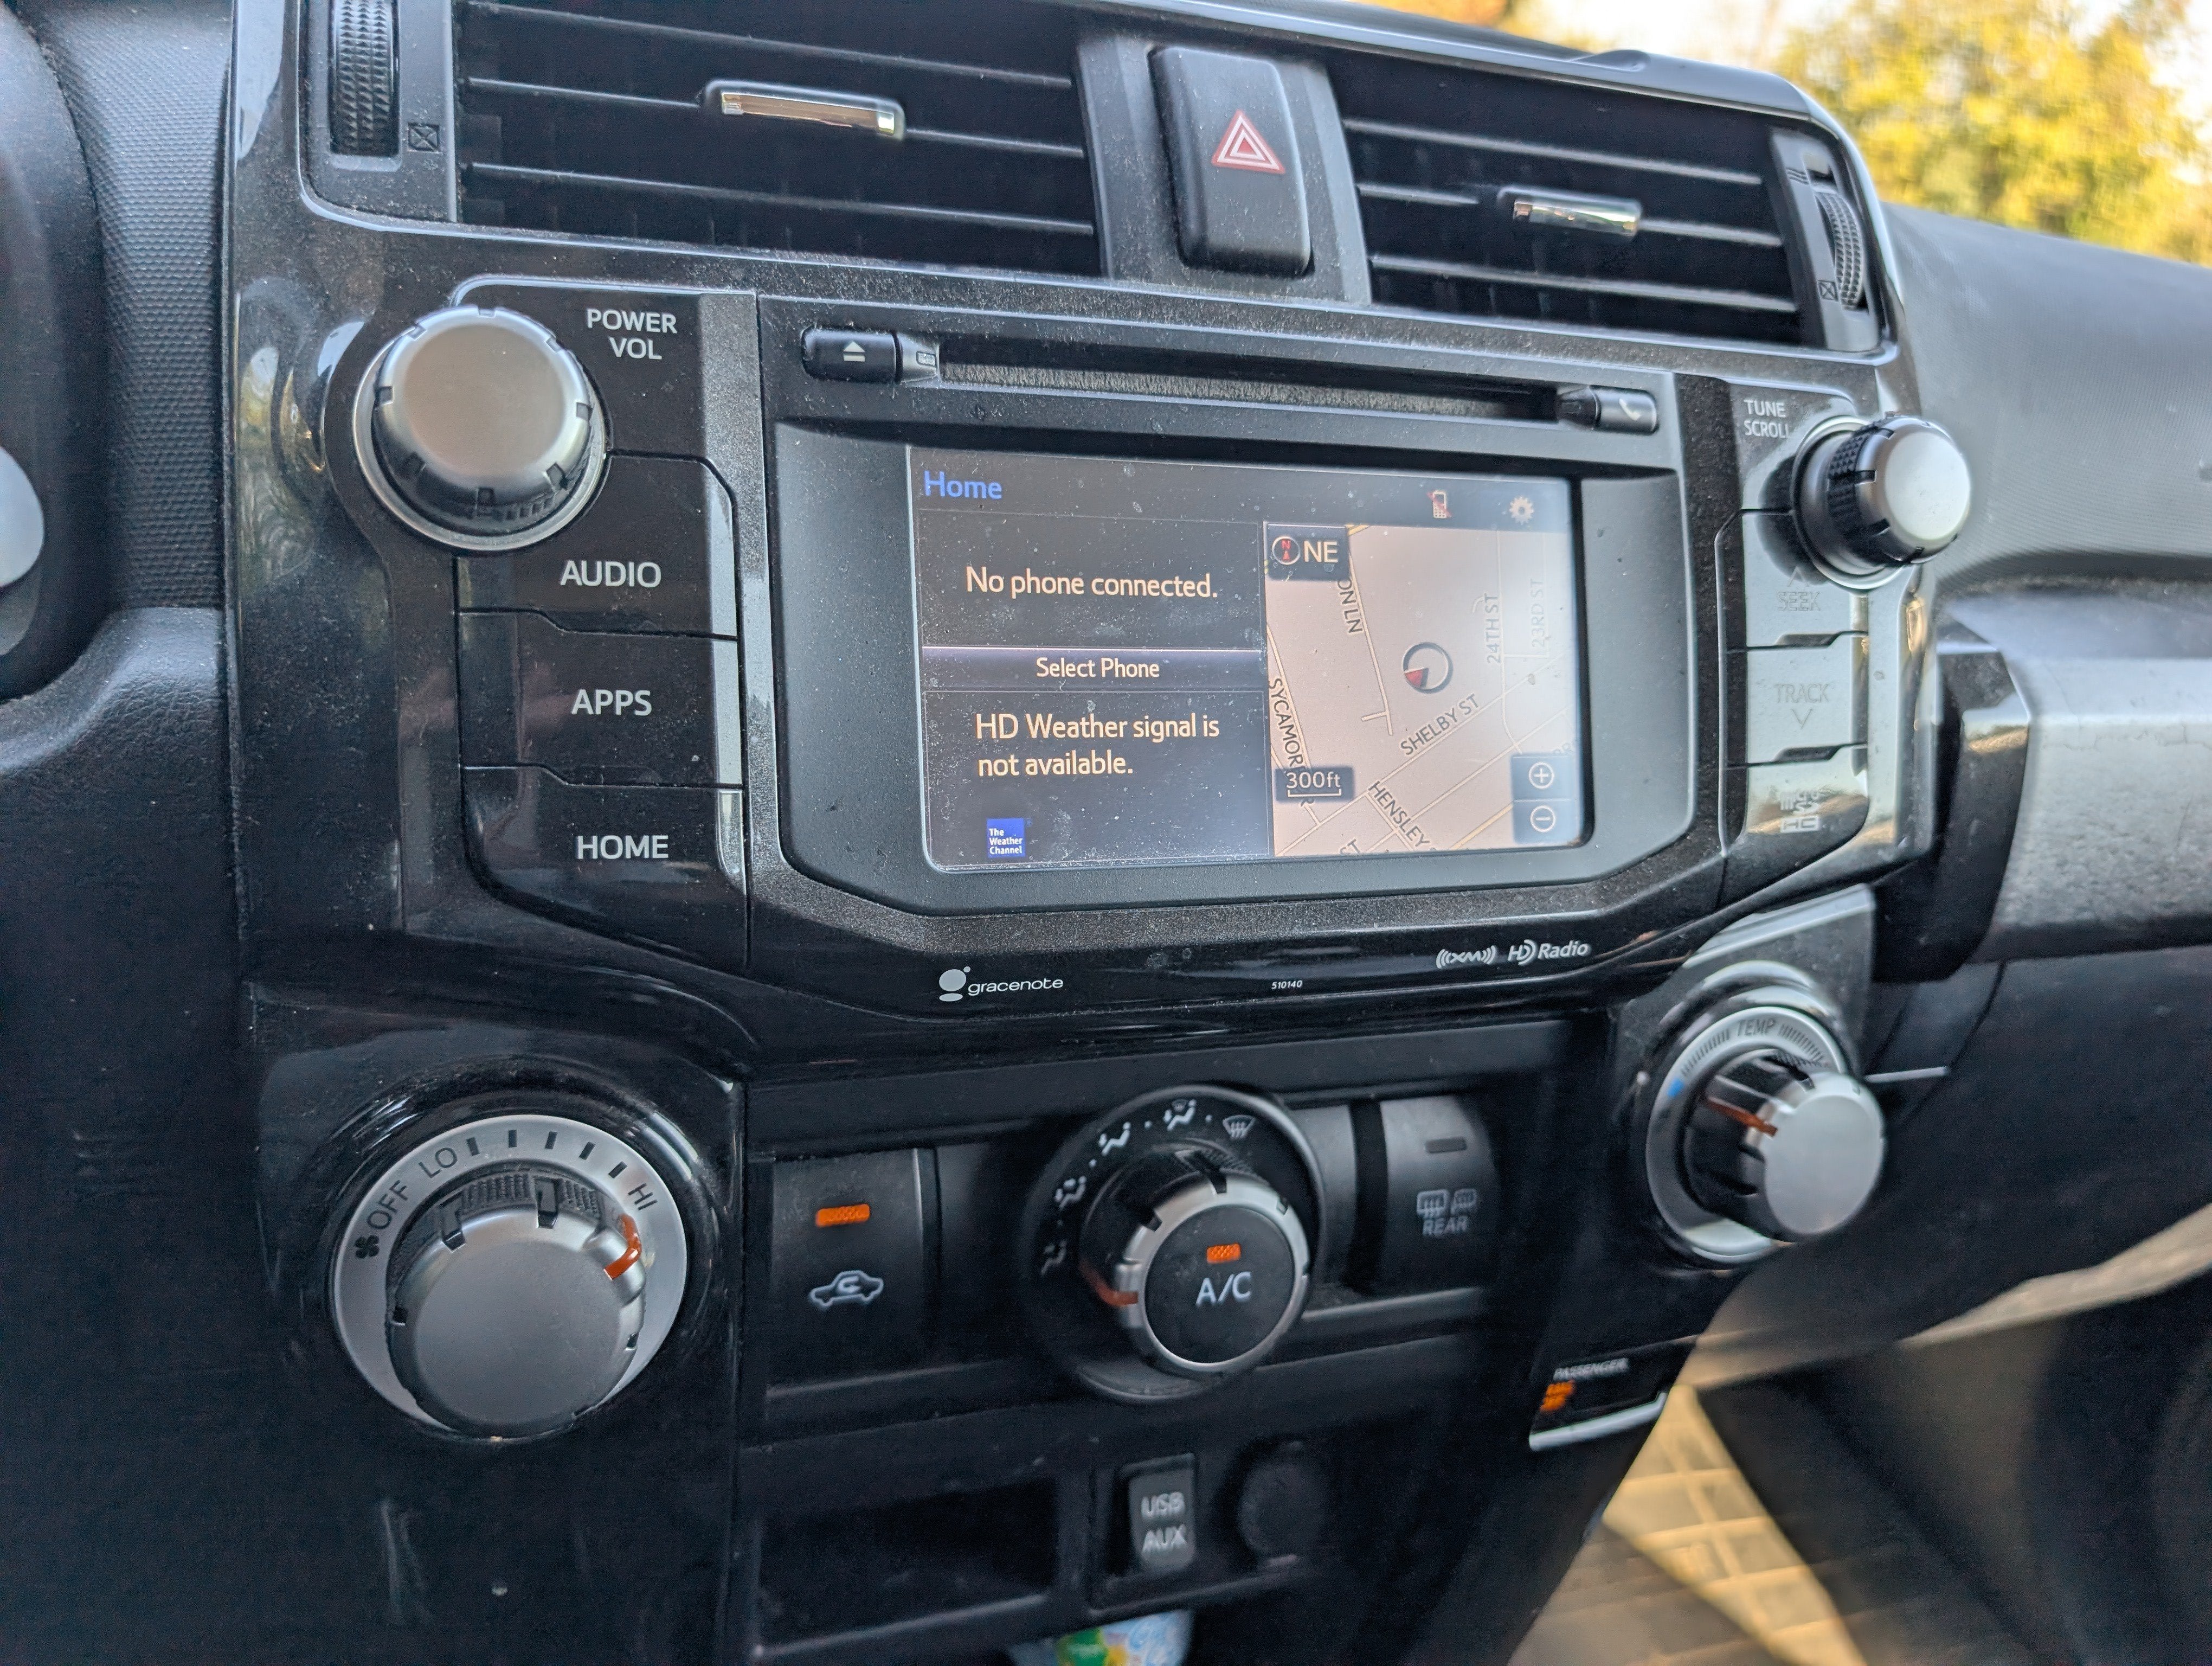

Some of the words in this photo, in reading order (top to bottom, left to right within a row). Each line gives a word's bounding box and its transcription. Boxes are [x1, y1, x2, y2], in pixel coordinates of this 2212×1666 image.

[587, 308, 677, 334] POWER
[609, 336, 663, 360] VOL
[1744, 400, 1786, 418] TUNE
[924, 470, 1003, 500] Home
[1303, 541, 1339, 563] NE
[560, 560, 662, 588] AUDIO
[966, 566, 1005, 593] No
[1011, 567, 1084, 599] phone
[1091, 573, 1218, 599] connected.
[1530, 578, 1544, 599] ST
[1776, 591, 1822, 612] SEEK
[1484, 593, 1500, 614] ST
[1344, 608, 1364, 635] LN
[1486, 618, 1501, 664] 24TH
[1036, 657, 1096, 678] Select
[1101, 657, 1160, 678] Phone
[571, 689, 652, 716] APPS
[1775, 683, 1830, 704] TRACK
[975, 713, 1019, 739] HD
[1026, 713, 1128, 739] Weather
[1133, 713, 1197, 744] signal
[1203, 714, 1220, 738] is
[1269, 677, 1304, 768] SYCAMOR
[1400, 707, 1459, 755] SHELBY
[1458, 693, 1480, 716] ST
[978, 753, 1020, 777] not
[1025, 749, 1134, 777] available.
[1285, 771, 1341, 789] 300ft
[1368, 780, 1431, 847] HENSLEY
[988, 828, 1005, 837] The
[988, 837, 1023, 845] Weather
[577, 835, 669, 860] HOME
[989, 845, 1023, 855] Channel
[1507, 939, 1538, 966] HD
[1538, 940, 1591, 960] Radio
[968, 977, 1064, 996] gracenote
[1271, 980, 1303, 990] 510140
[1737, 1018, 1777, 1037] TEMP
[418, 1146, 458, 1179] LO
[366, 1180, 410, 1230] OFF
[628, 1183, 658, 1211] HI
[1422, 1215, 1469, 1236] REAR
[1195, 1271, 1252, 1306] A/C
[1141, 1492, 1186, 1518] USB
[1142, 1524, 1187, 1552] AUX
